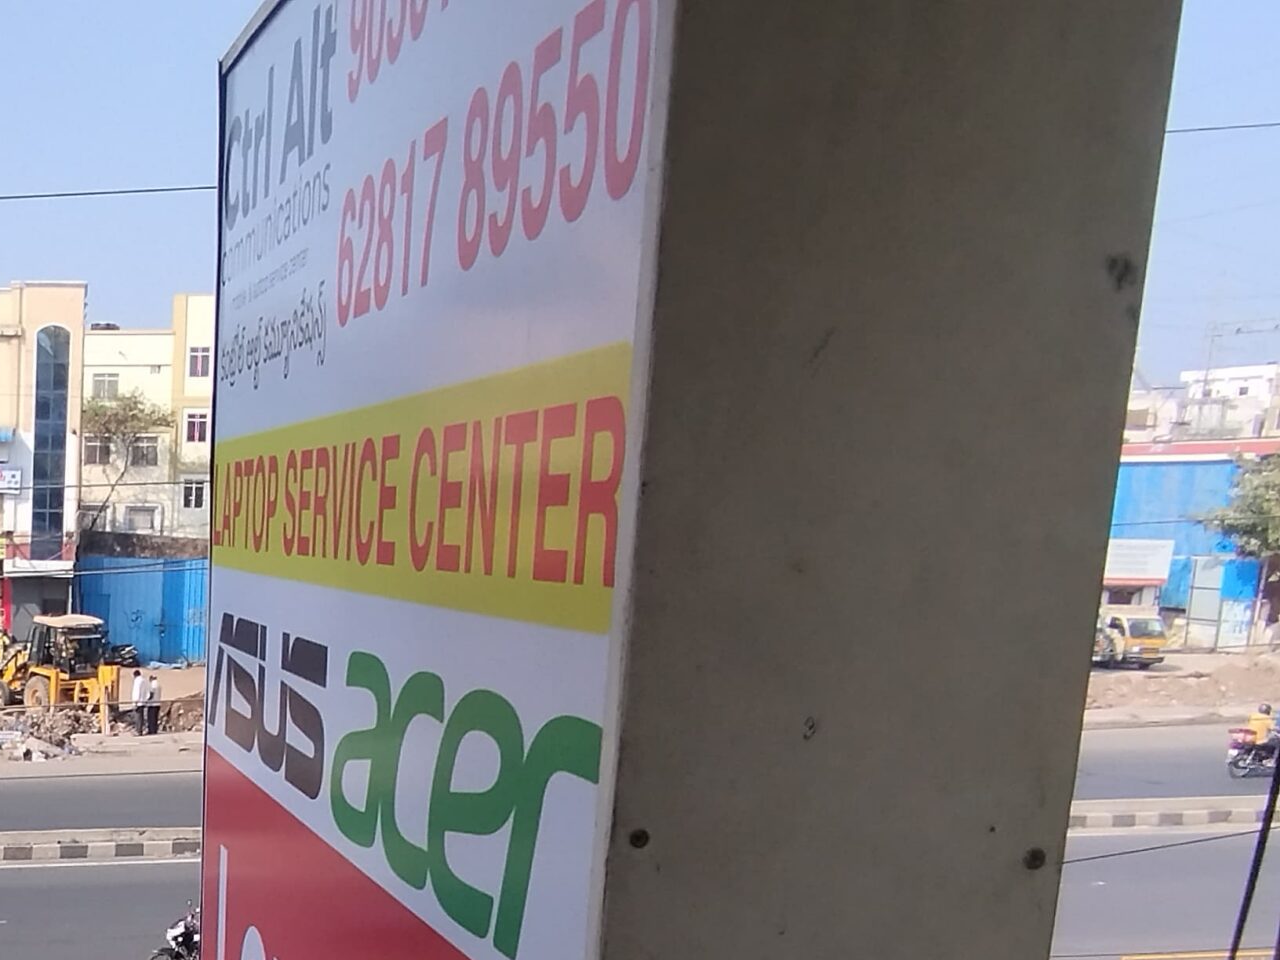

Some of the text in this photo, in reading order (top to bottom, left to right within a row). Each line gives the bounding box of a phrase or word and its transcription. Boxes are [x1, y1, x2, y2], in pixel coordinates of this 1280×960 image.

[224, 65, 275, 230] Ctrl
[280, 0, 337, 184] Alt
[336, 117, 449, 327] 62817
[457, 0, 651, 271] 89550
[213, 396, 626, 588] LAPTOP SERVICE CENTER
